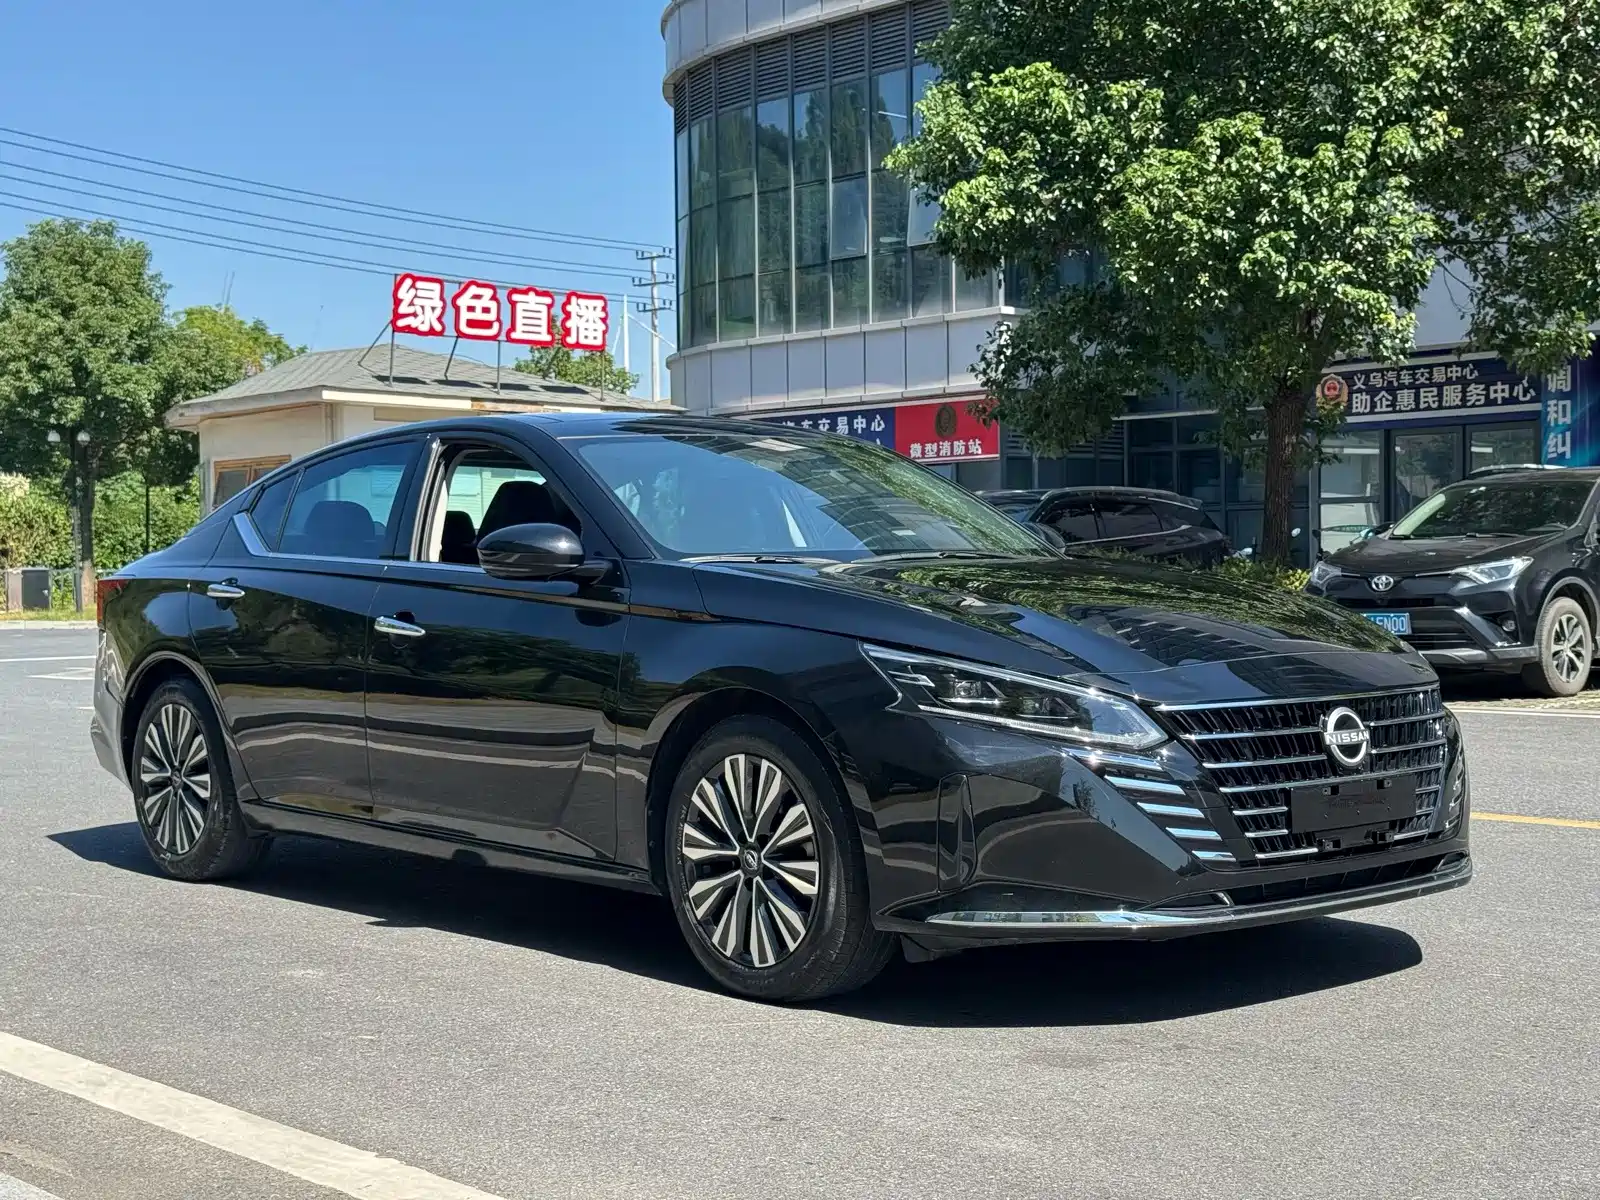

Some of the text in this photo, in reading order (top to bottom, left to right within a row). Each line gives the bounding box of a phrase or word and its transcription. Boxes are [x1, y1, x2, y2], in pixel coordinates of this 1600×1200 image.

[396, 277, 606, 346] 绿色直播
[1353, 363, 1479, 390] 义乌汽车交易中心
[1352, 377, 1537, 414] 助企惠民服务中心
[782, 415, 886, 435] 交易中心
[910, 439, 982, 458] 微型消防站
[1326, 730, 1369, 744] NISSAN
